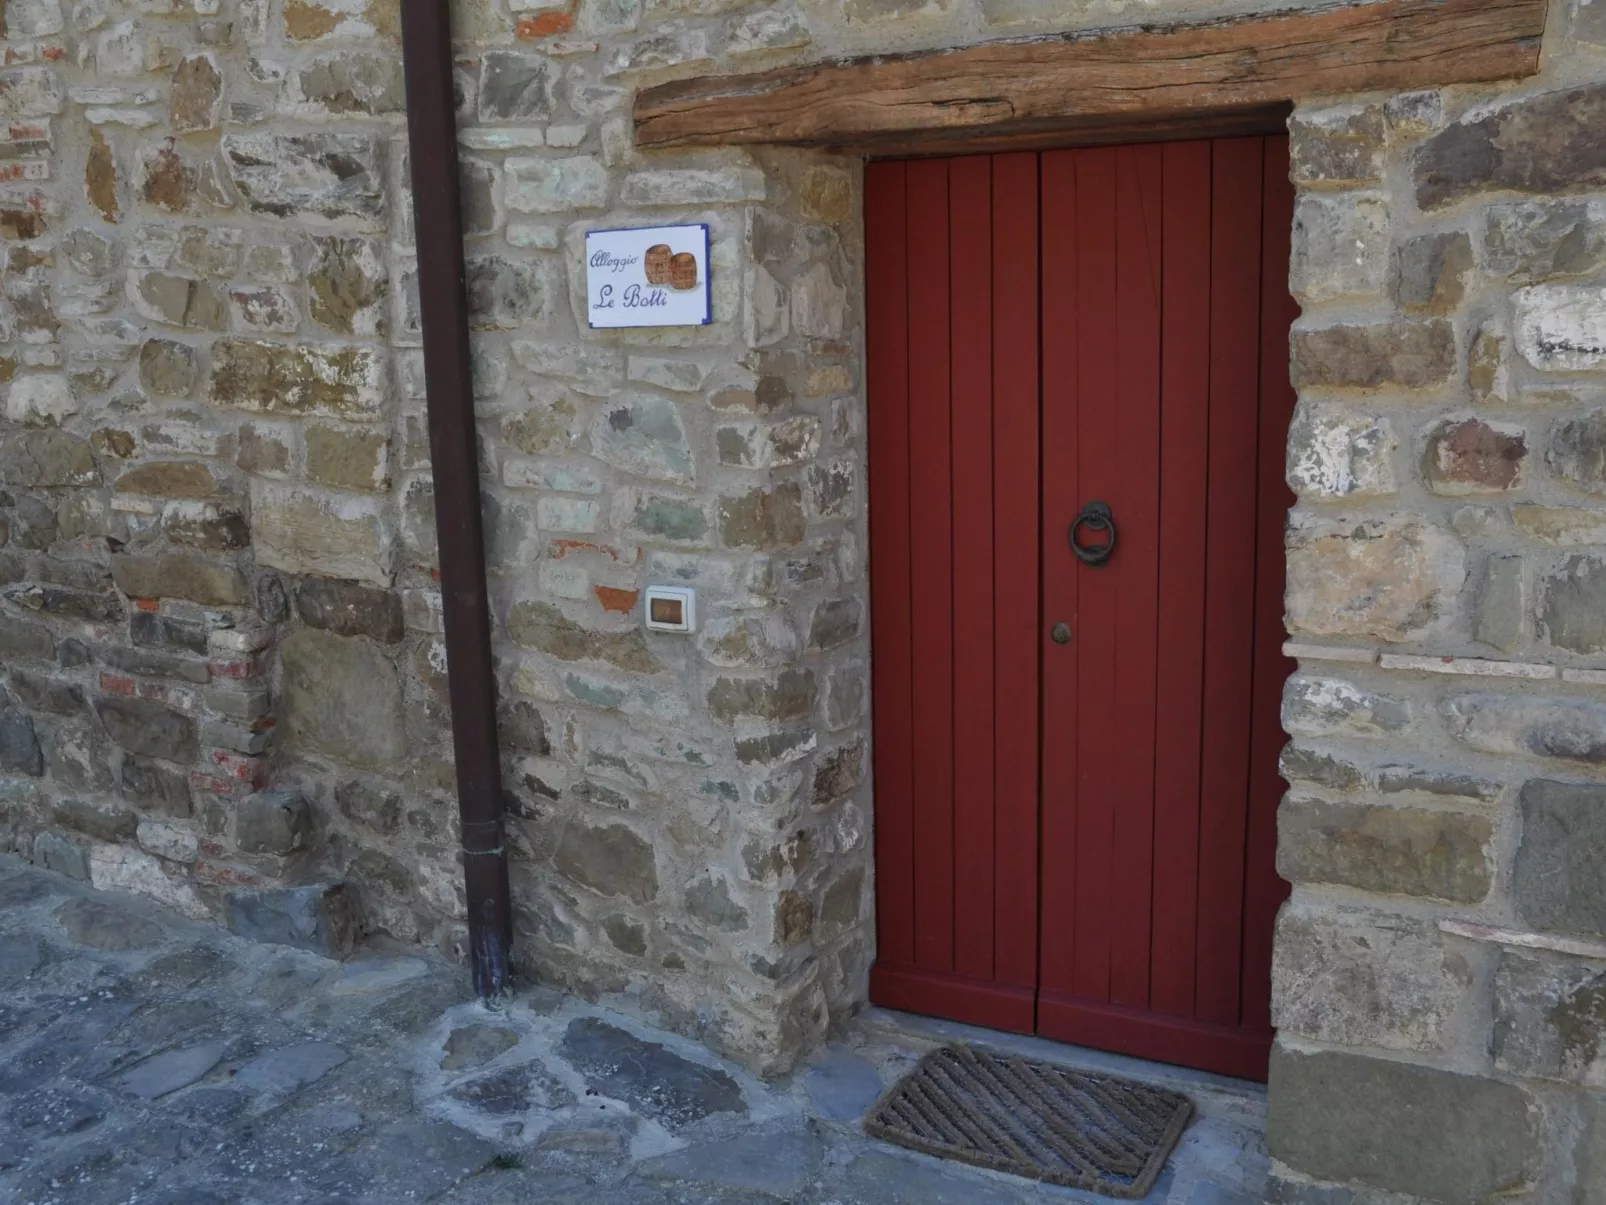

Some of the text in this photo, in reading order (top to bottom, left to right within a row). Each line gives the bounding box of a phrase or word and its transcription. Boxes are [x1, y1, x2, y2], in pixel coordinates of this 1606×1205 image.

[590, 249, 639, 273] Alloggio
[592, 283, 668, 309] Le Botti
